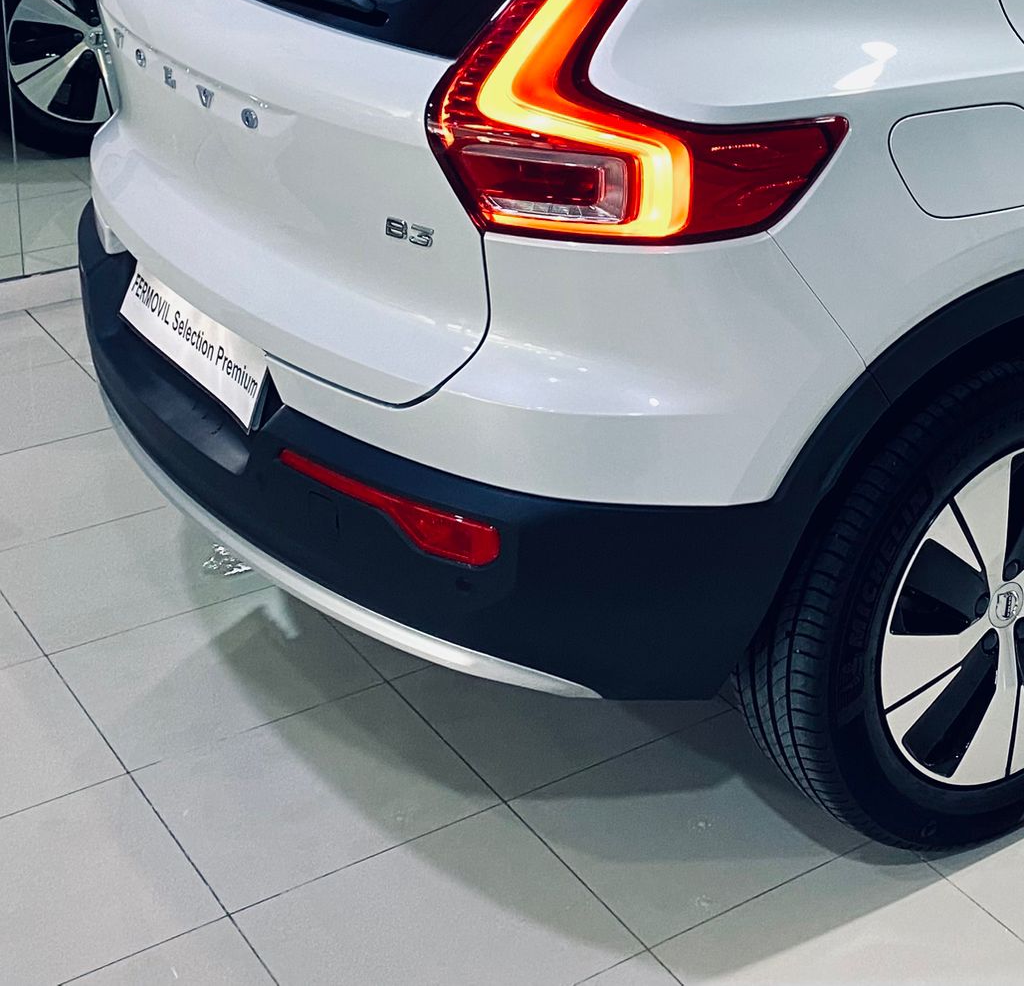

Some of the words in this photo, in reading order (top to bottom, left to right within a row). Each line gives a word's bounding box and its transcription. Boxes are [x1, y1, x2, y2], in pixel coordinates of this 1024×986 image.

[384, 216, 435, 248] B3
[130, 273, 171, 326] FERMOVIL
[171, 310, 216, 362] Selection
[214, 346, 260, 399] Premium
